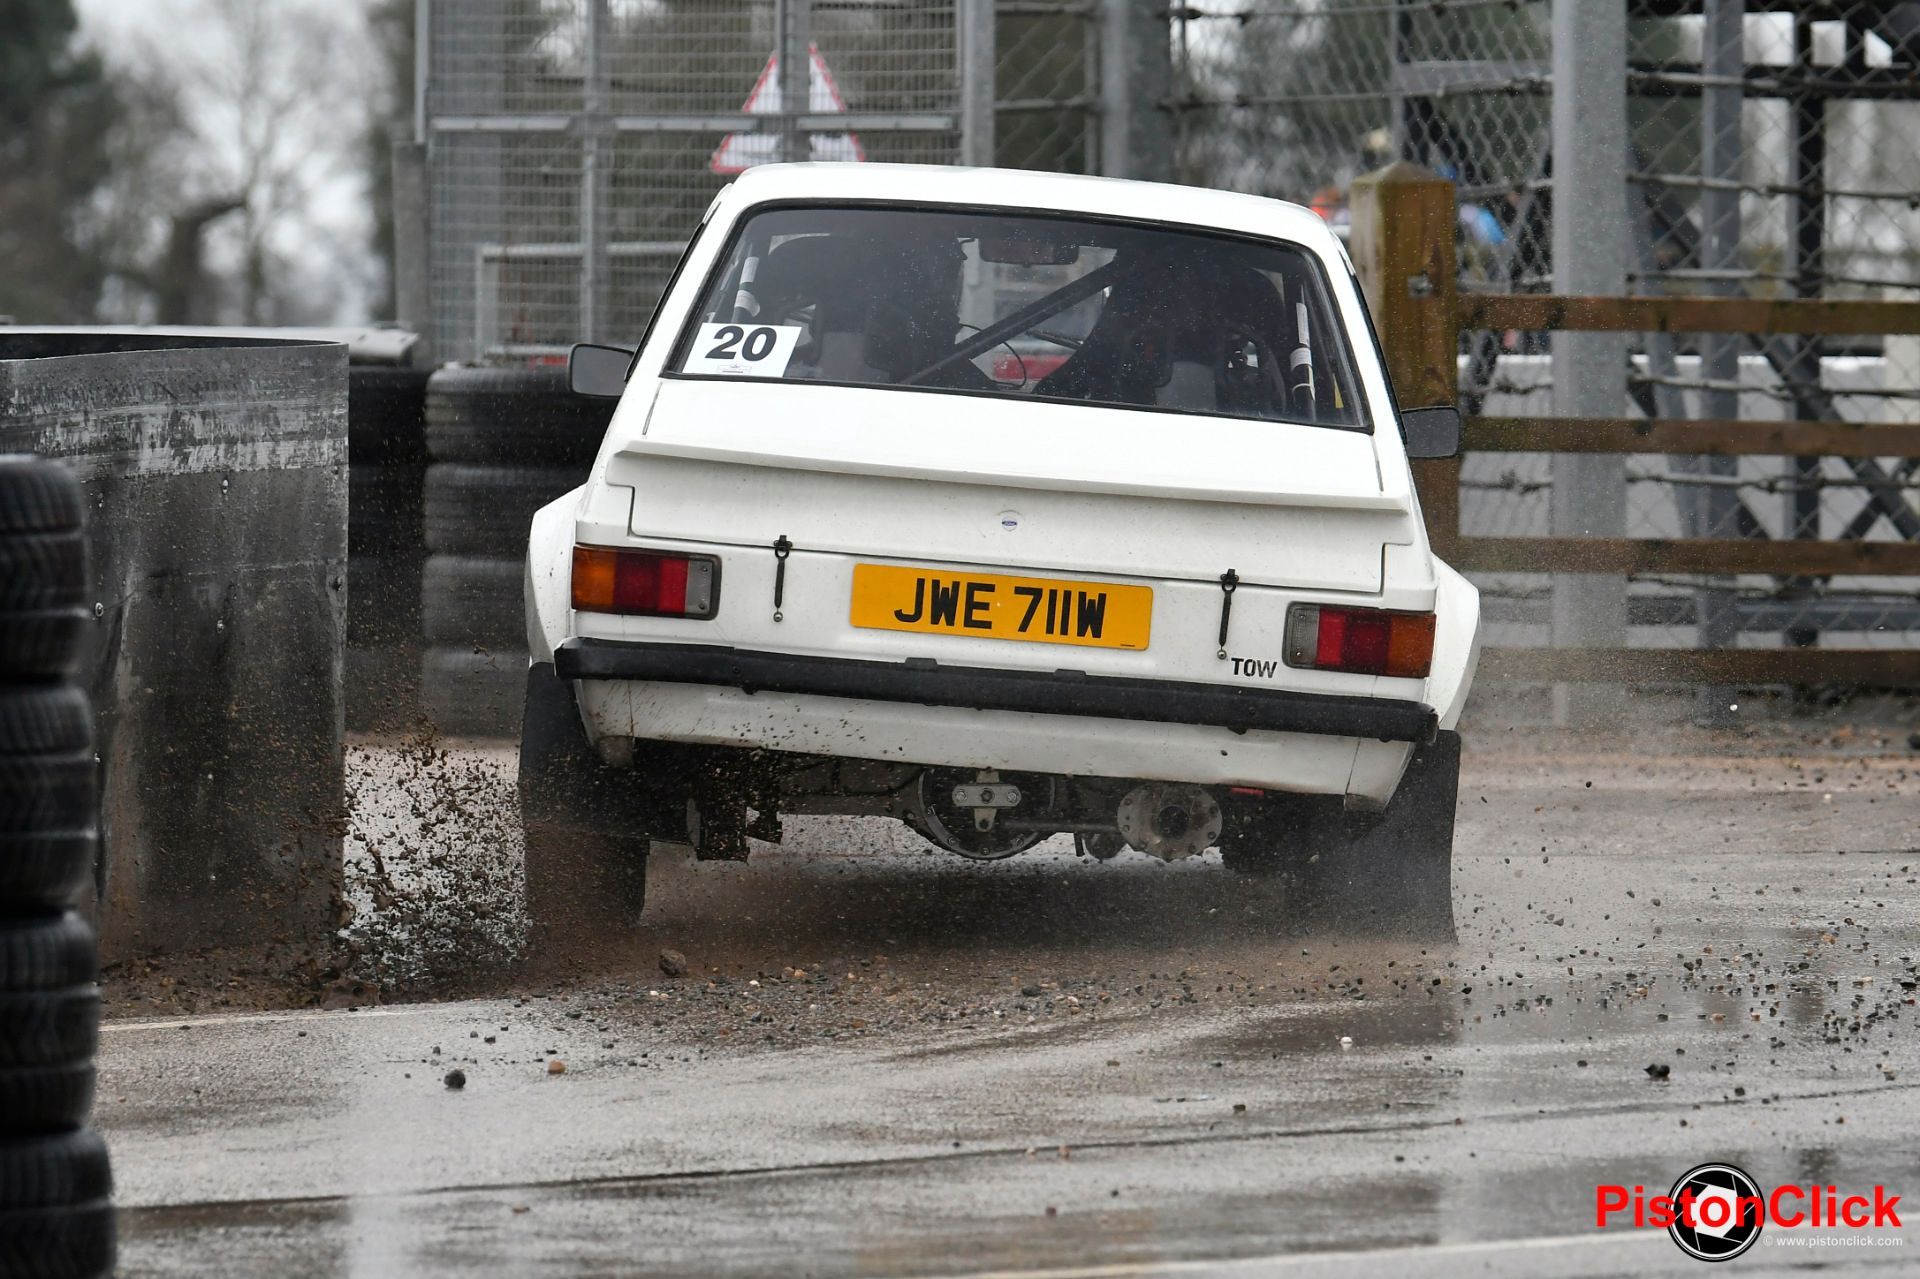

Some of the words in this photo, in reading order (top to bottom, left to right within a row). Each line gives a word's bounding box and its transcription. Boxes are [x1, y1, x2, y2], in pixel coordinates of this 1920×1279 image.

[704, 325, 777, 362] 20
[894, 578, 996, 630] JWE
[1014, 586, 1107, 639] 711W
[1231, 657, 1278, 679] TOW
